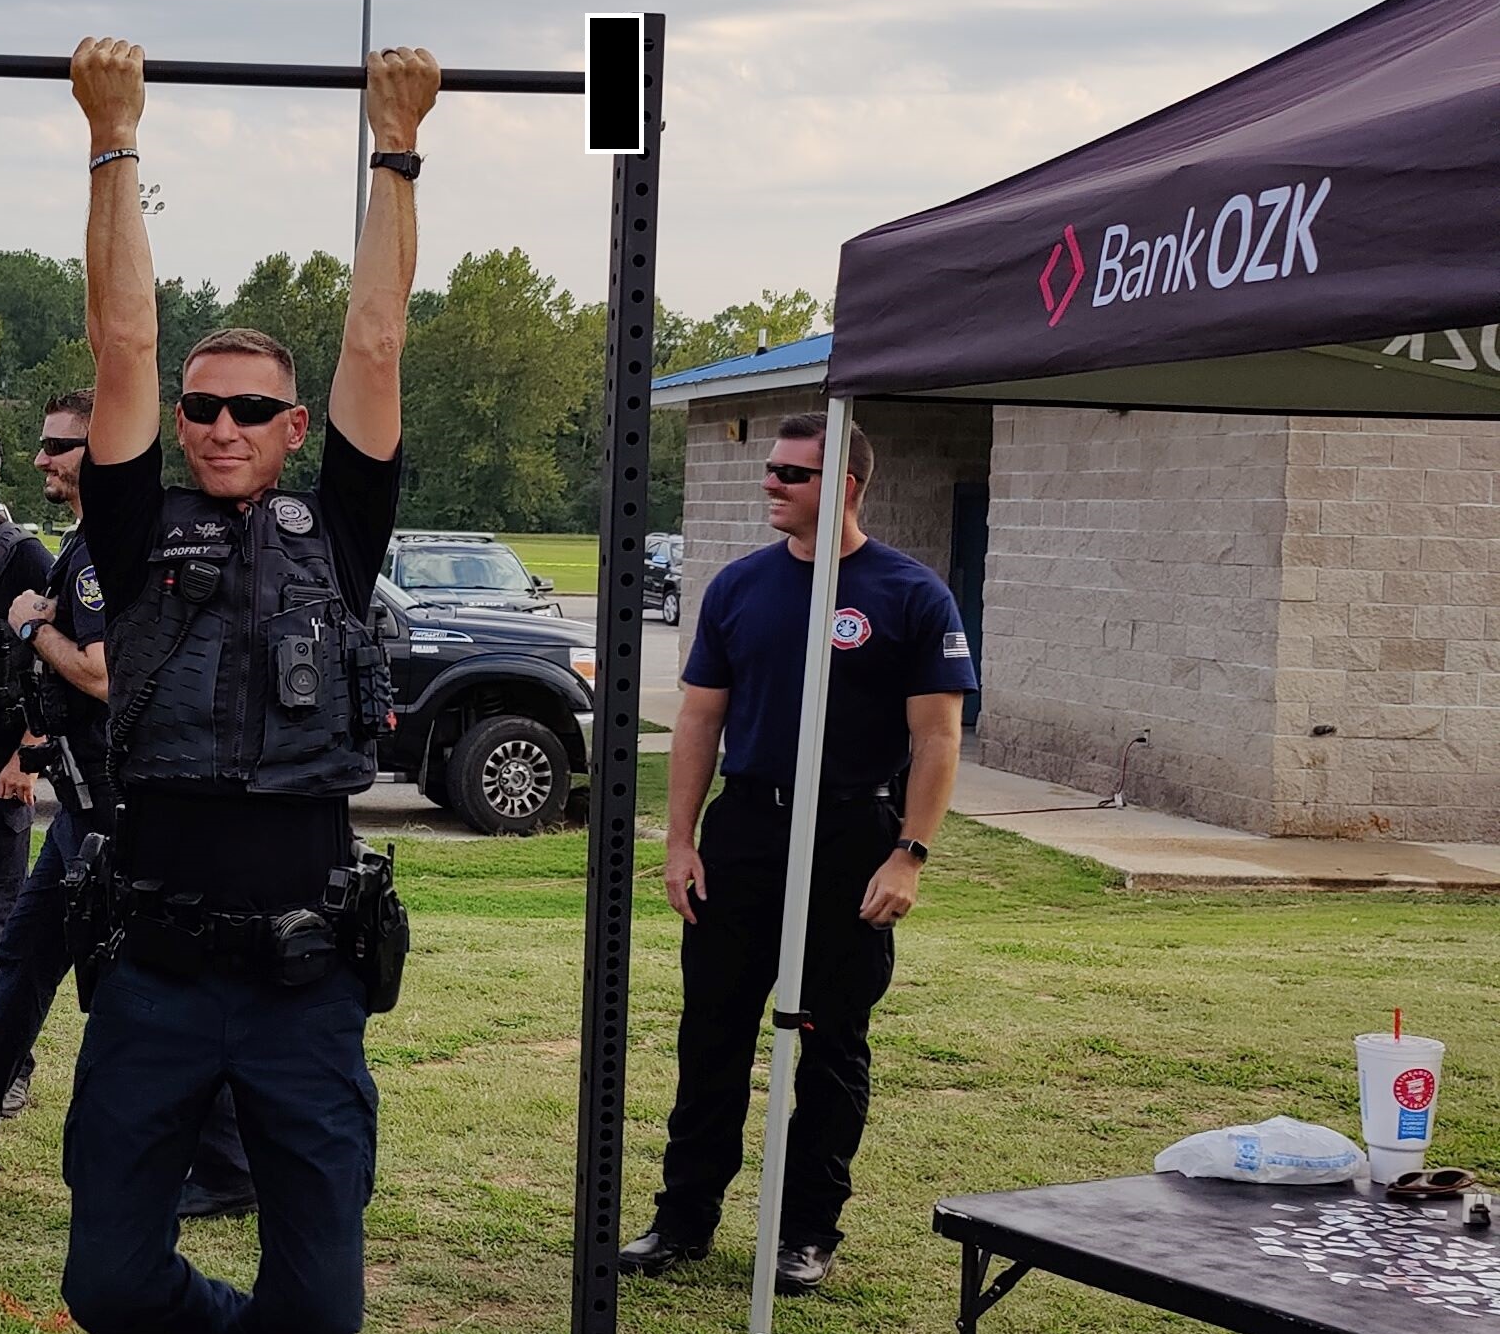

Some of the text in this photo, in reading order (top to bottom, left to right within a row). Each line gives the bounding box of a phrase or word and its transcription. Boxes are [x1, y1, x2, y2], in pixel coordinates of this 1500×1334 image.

[1093, 178, 1330, 307] Bank OZK
[164, 546, 211, 557] GODFREY
